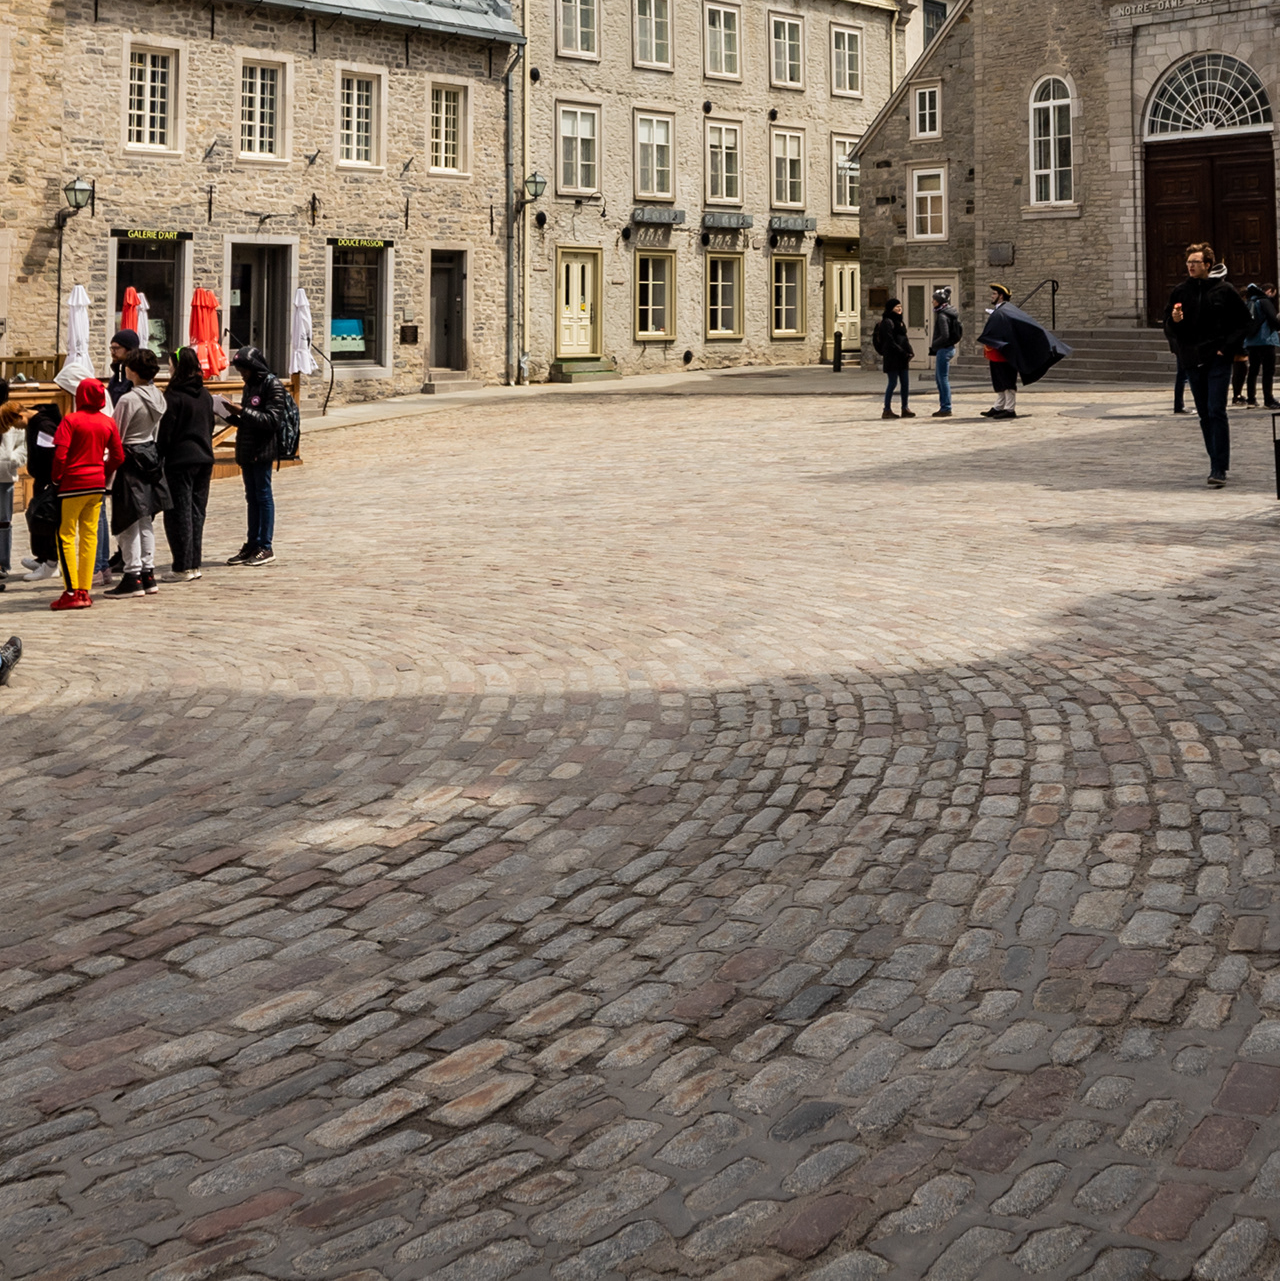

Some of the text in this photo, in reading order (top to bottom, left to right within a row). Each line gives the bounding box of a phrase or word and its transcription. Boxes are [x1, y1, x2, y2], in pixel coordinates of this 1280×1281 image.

[128, 230, 178, 240] GALERIE D'ART
[338, 239, 384, 248] DOUCE PASSION
